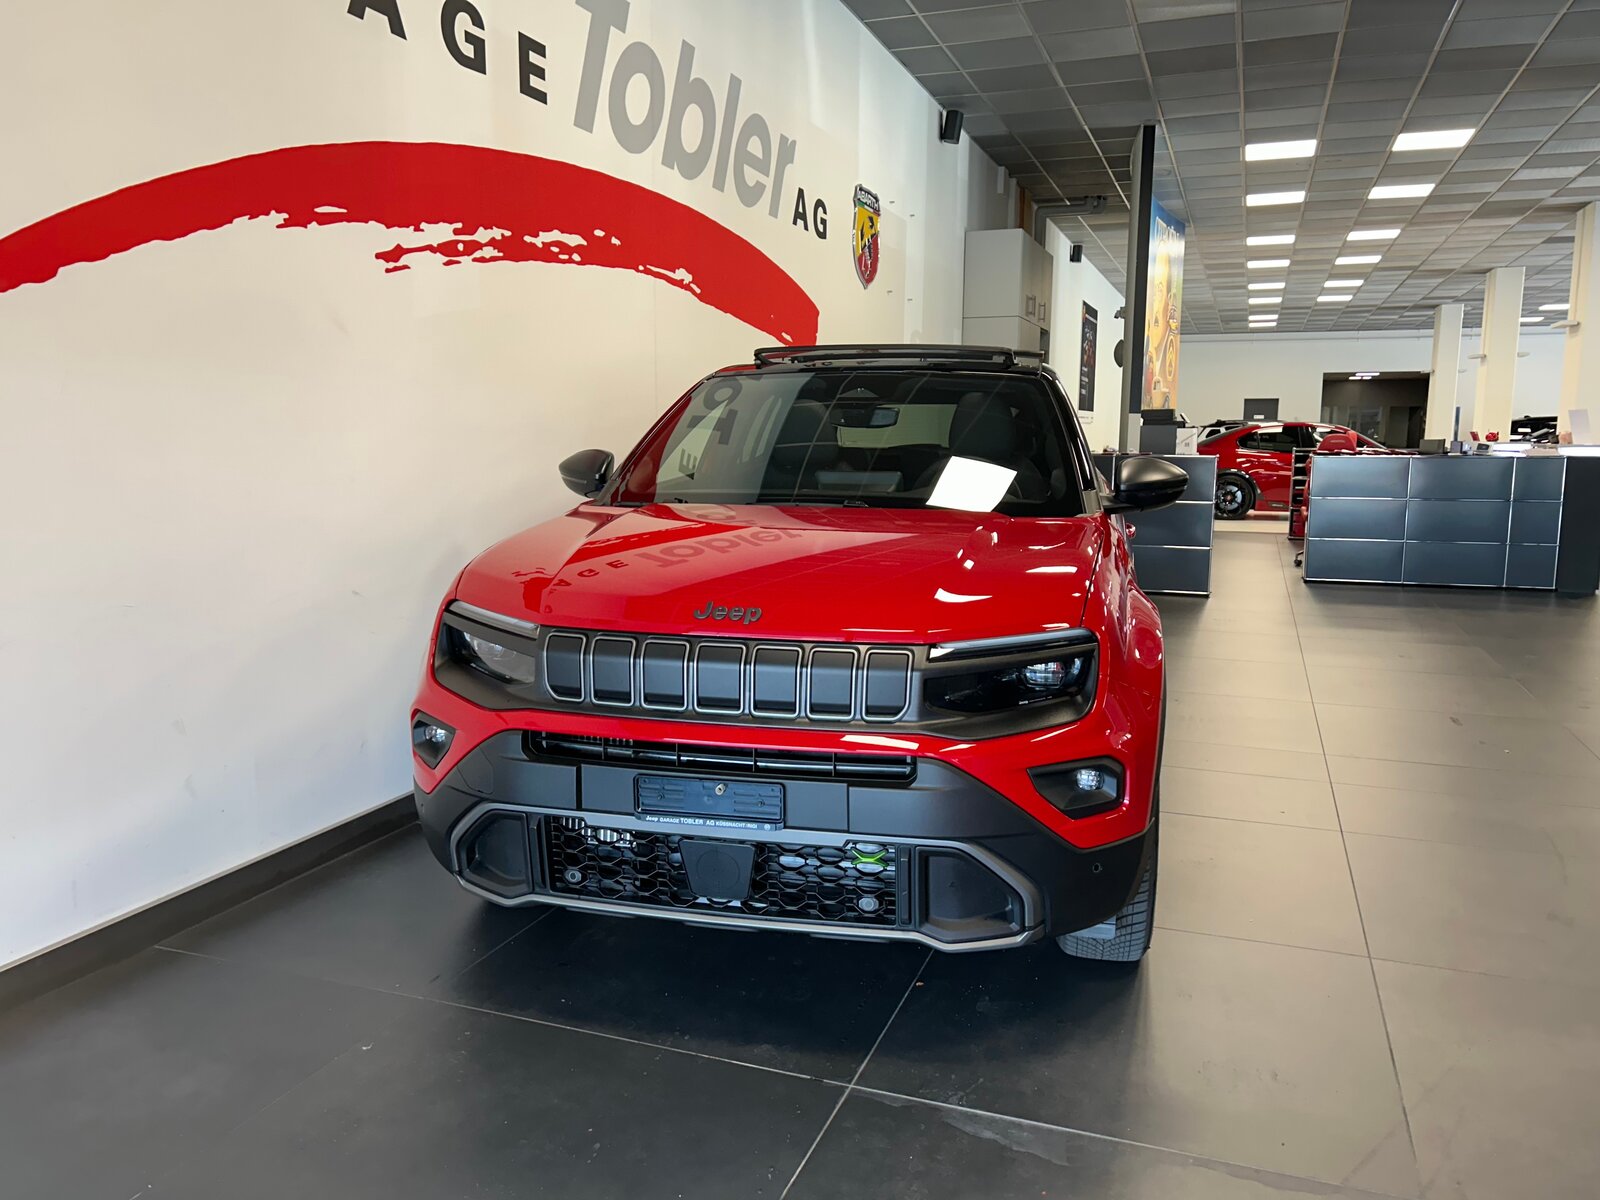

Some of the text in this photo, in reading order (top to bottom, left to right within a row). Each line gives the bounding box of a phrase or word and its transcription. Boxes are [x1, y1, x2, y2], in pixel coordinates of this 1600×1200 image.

[573, 0, 797, 219] Tobler
[792, 187, 828, 240] AG
[693, 600, 762, 625] Jeep
[645, 815, 659, 823] Jeep
[680, 817, 704, 825] TOBLER
